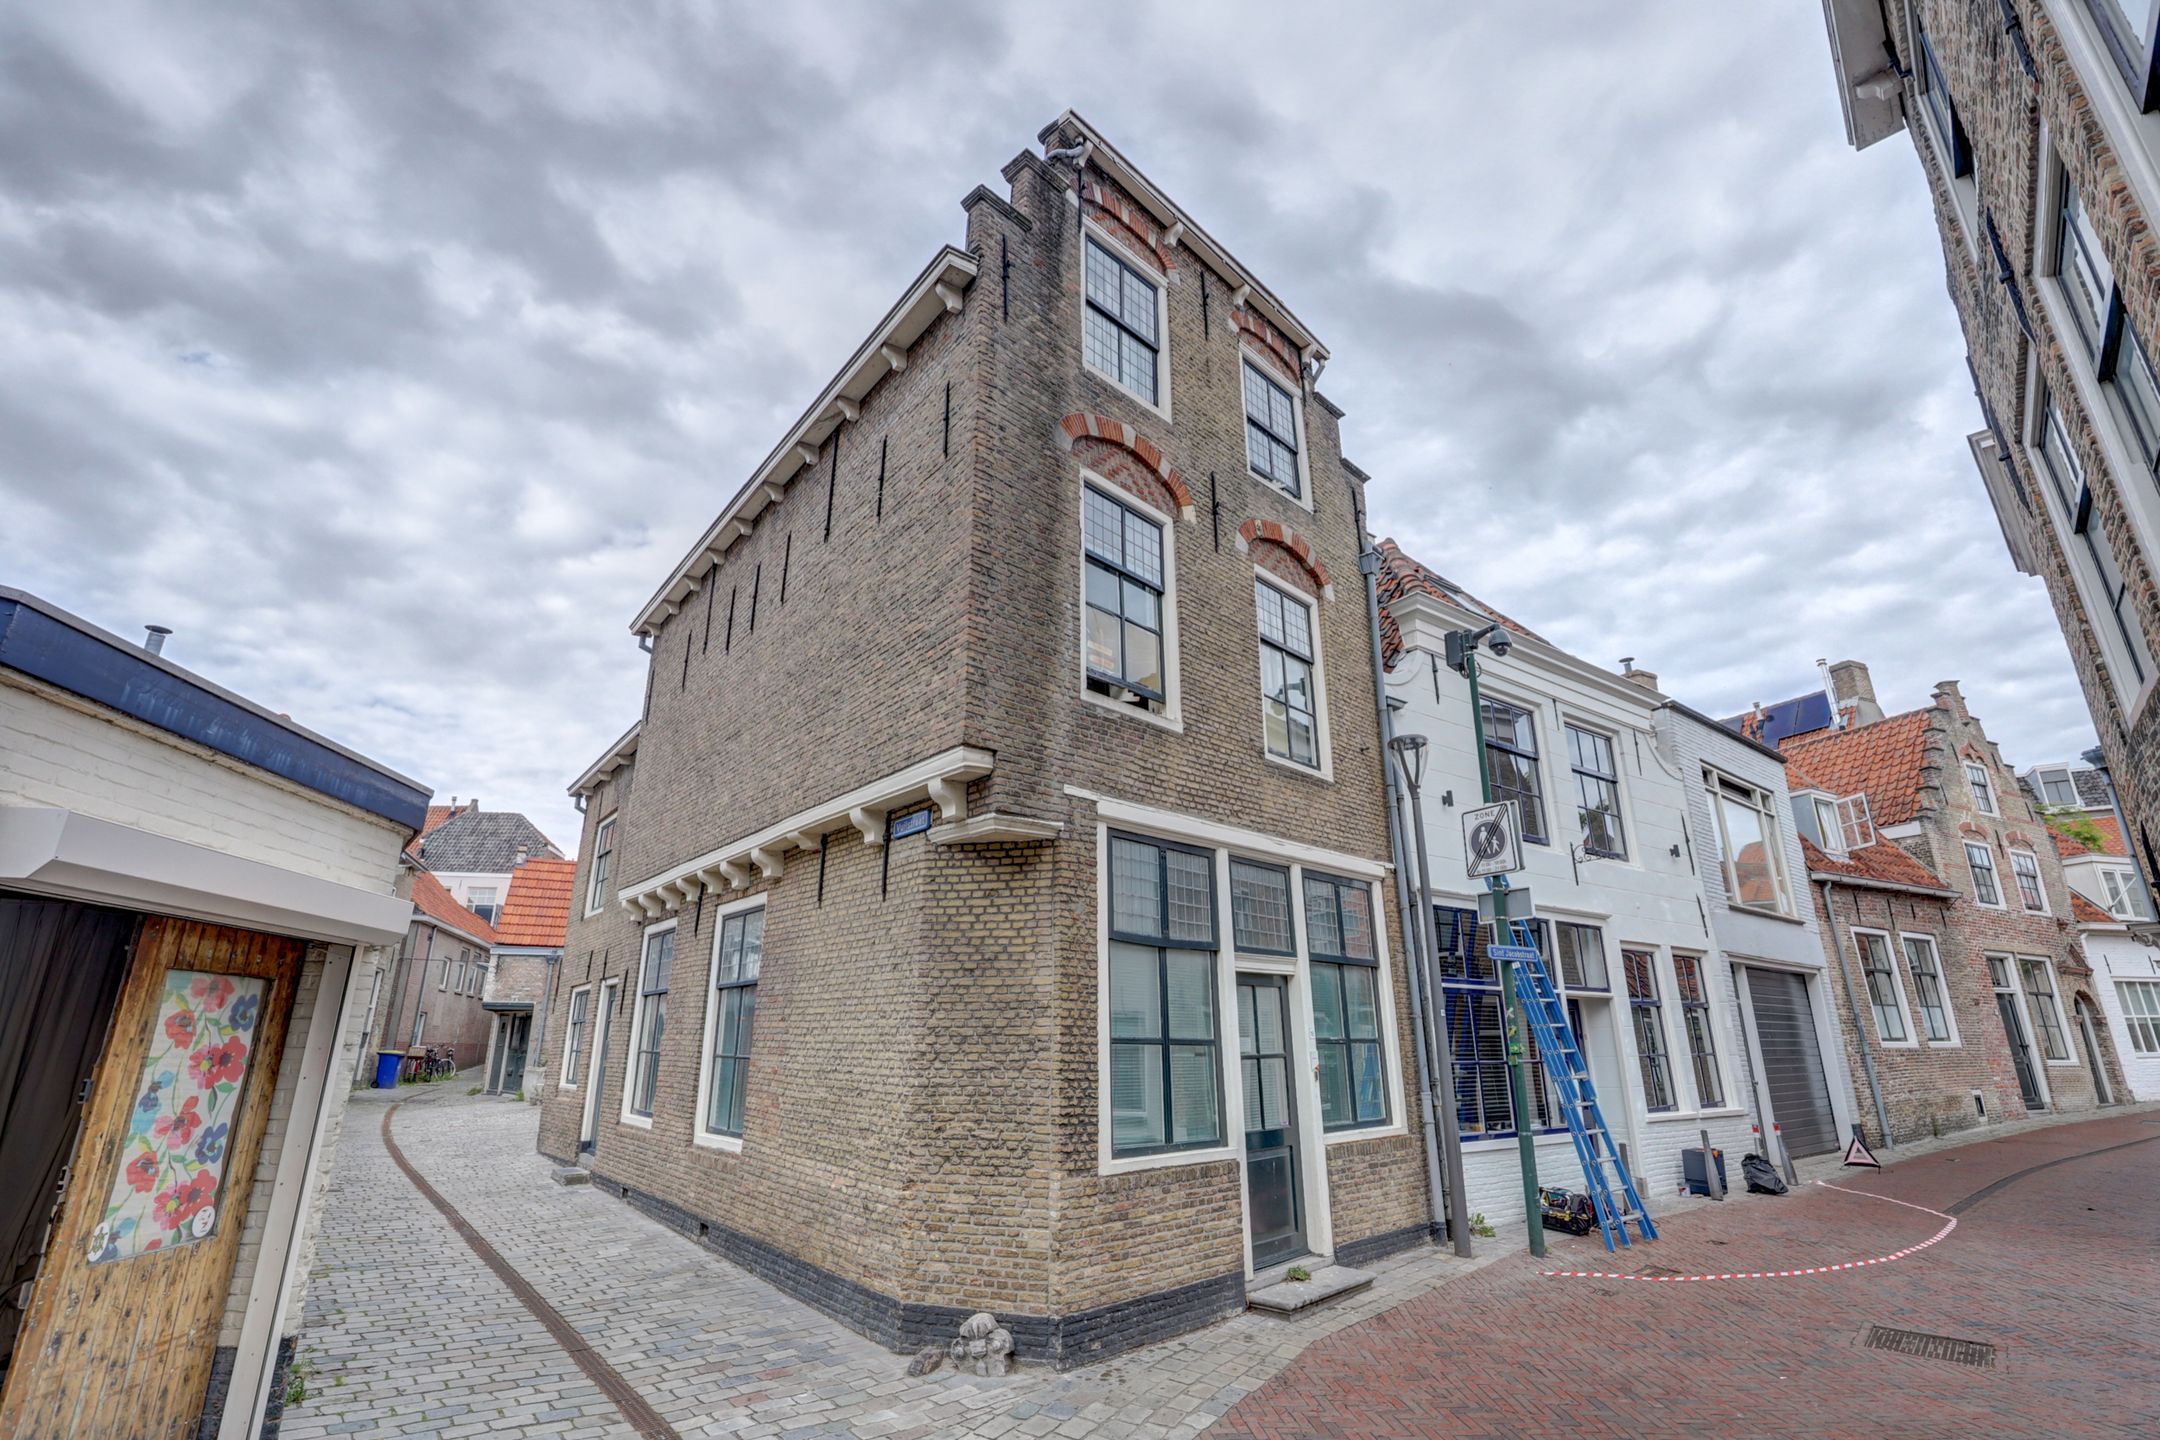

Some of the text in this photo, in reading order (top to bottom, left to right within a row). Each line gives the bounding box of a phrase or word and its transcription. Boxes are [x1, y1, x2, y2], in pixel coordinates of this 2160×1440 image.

[1474, 810, 1495, 820] ZONE
[1492, 948, 1535, 958] Sint Jacobstraat
